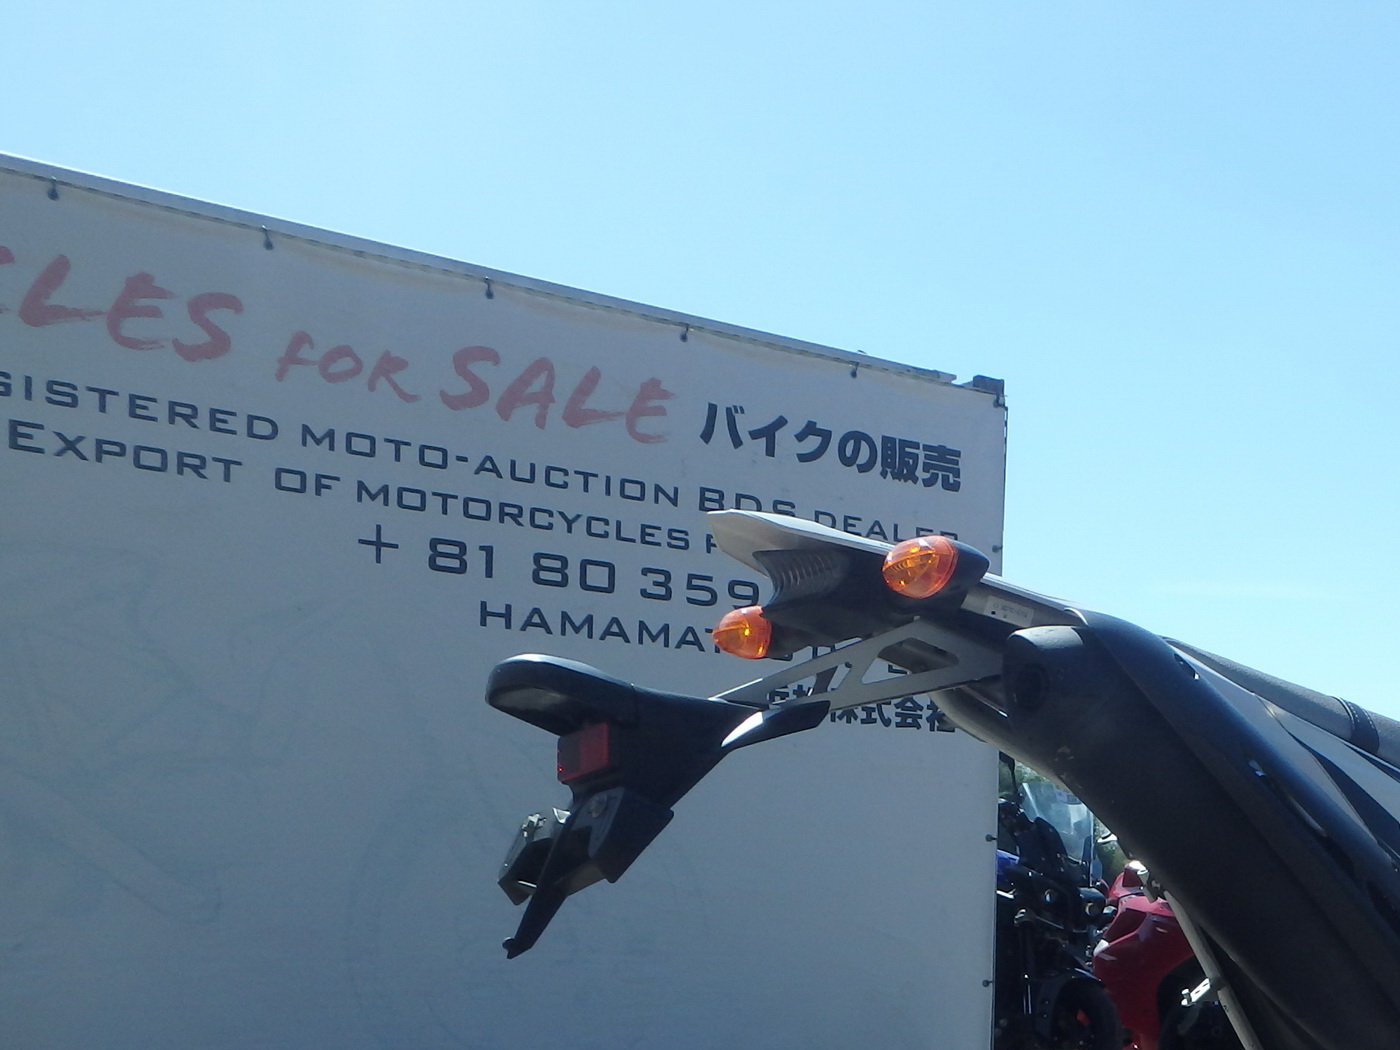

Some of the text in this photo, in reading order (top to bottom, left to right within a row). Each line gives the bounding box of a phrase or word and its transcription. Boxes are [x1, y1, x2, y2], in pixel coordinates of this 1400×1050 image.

[0, 245, 243, 362] LES
[440, 346, 675, 444] SALE
[8, 419, 690, 551] EXPORT OF MOTORCYCLES
[301, 423, 679, 508] MOTO-AUCTION
[700, 402, 962, 492] バイクの販売
[532, 552, 616, 595] 80
[479, 600, 724, 654] HAMAMA
